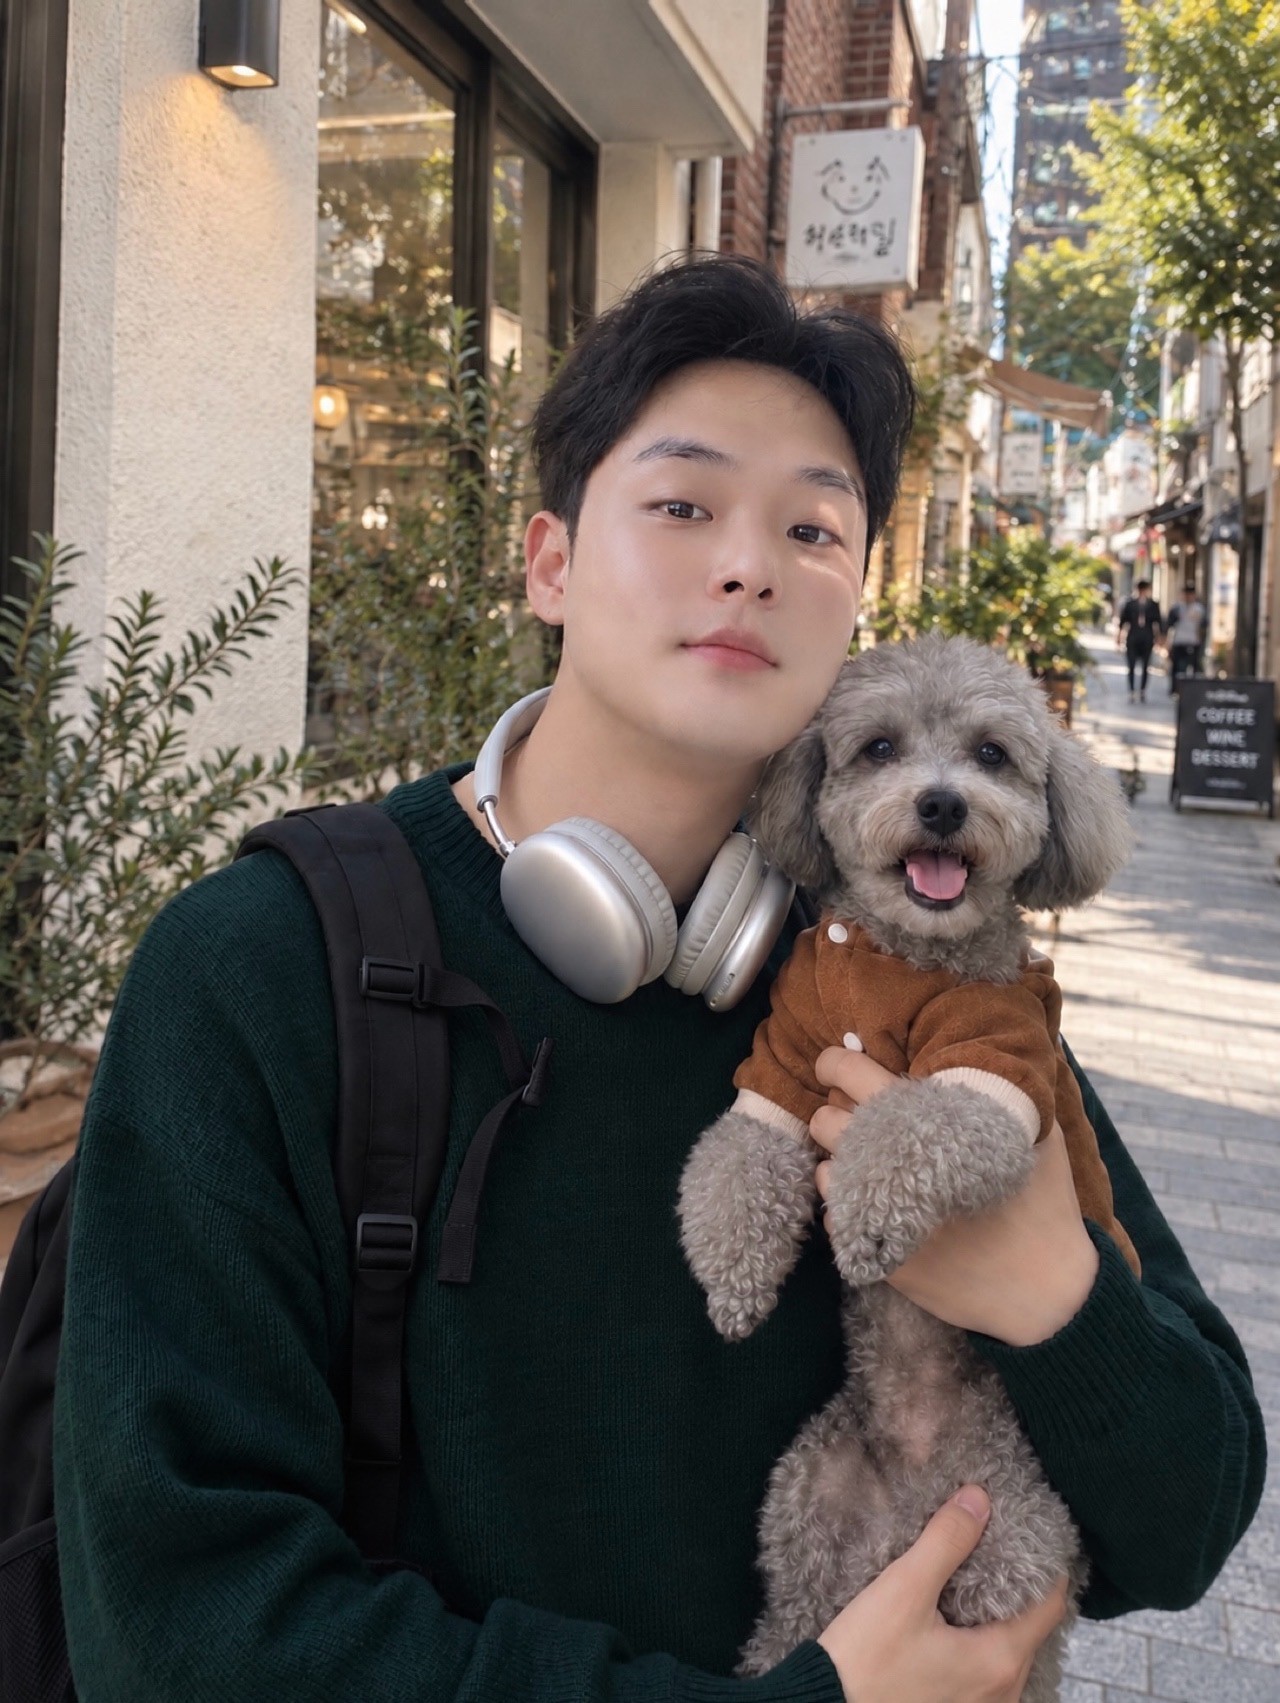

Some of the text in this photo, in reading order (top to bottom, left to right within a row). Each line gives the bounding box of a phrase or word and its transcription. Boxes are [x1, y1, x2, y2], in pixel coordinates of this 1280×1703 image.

[1196, 706, 1256, 726] COFFEE
[1205, 729, 1247, 748] WINE
[1191, 748, 1260, 769] DESSERT
